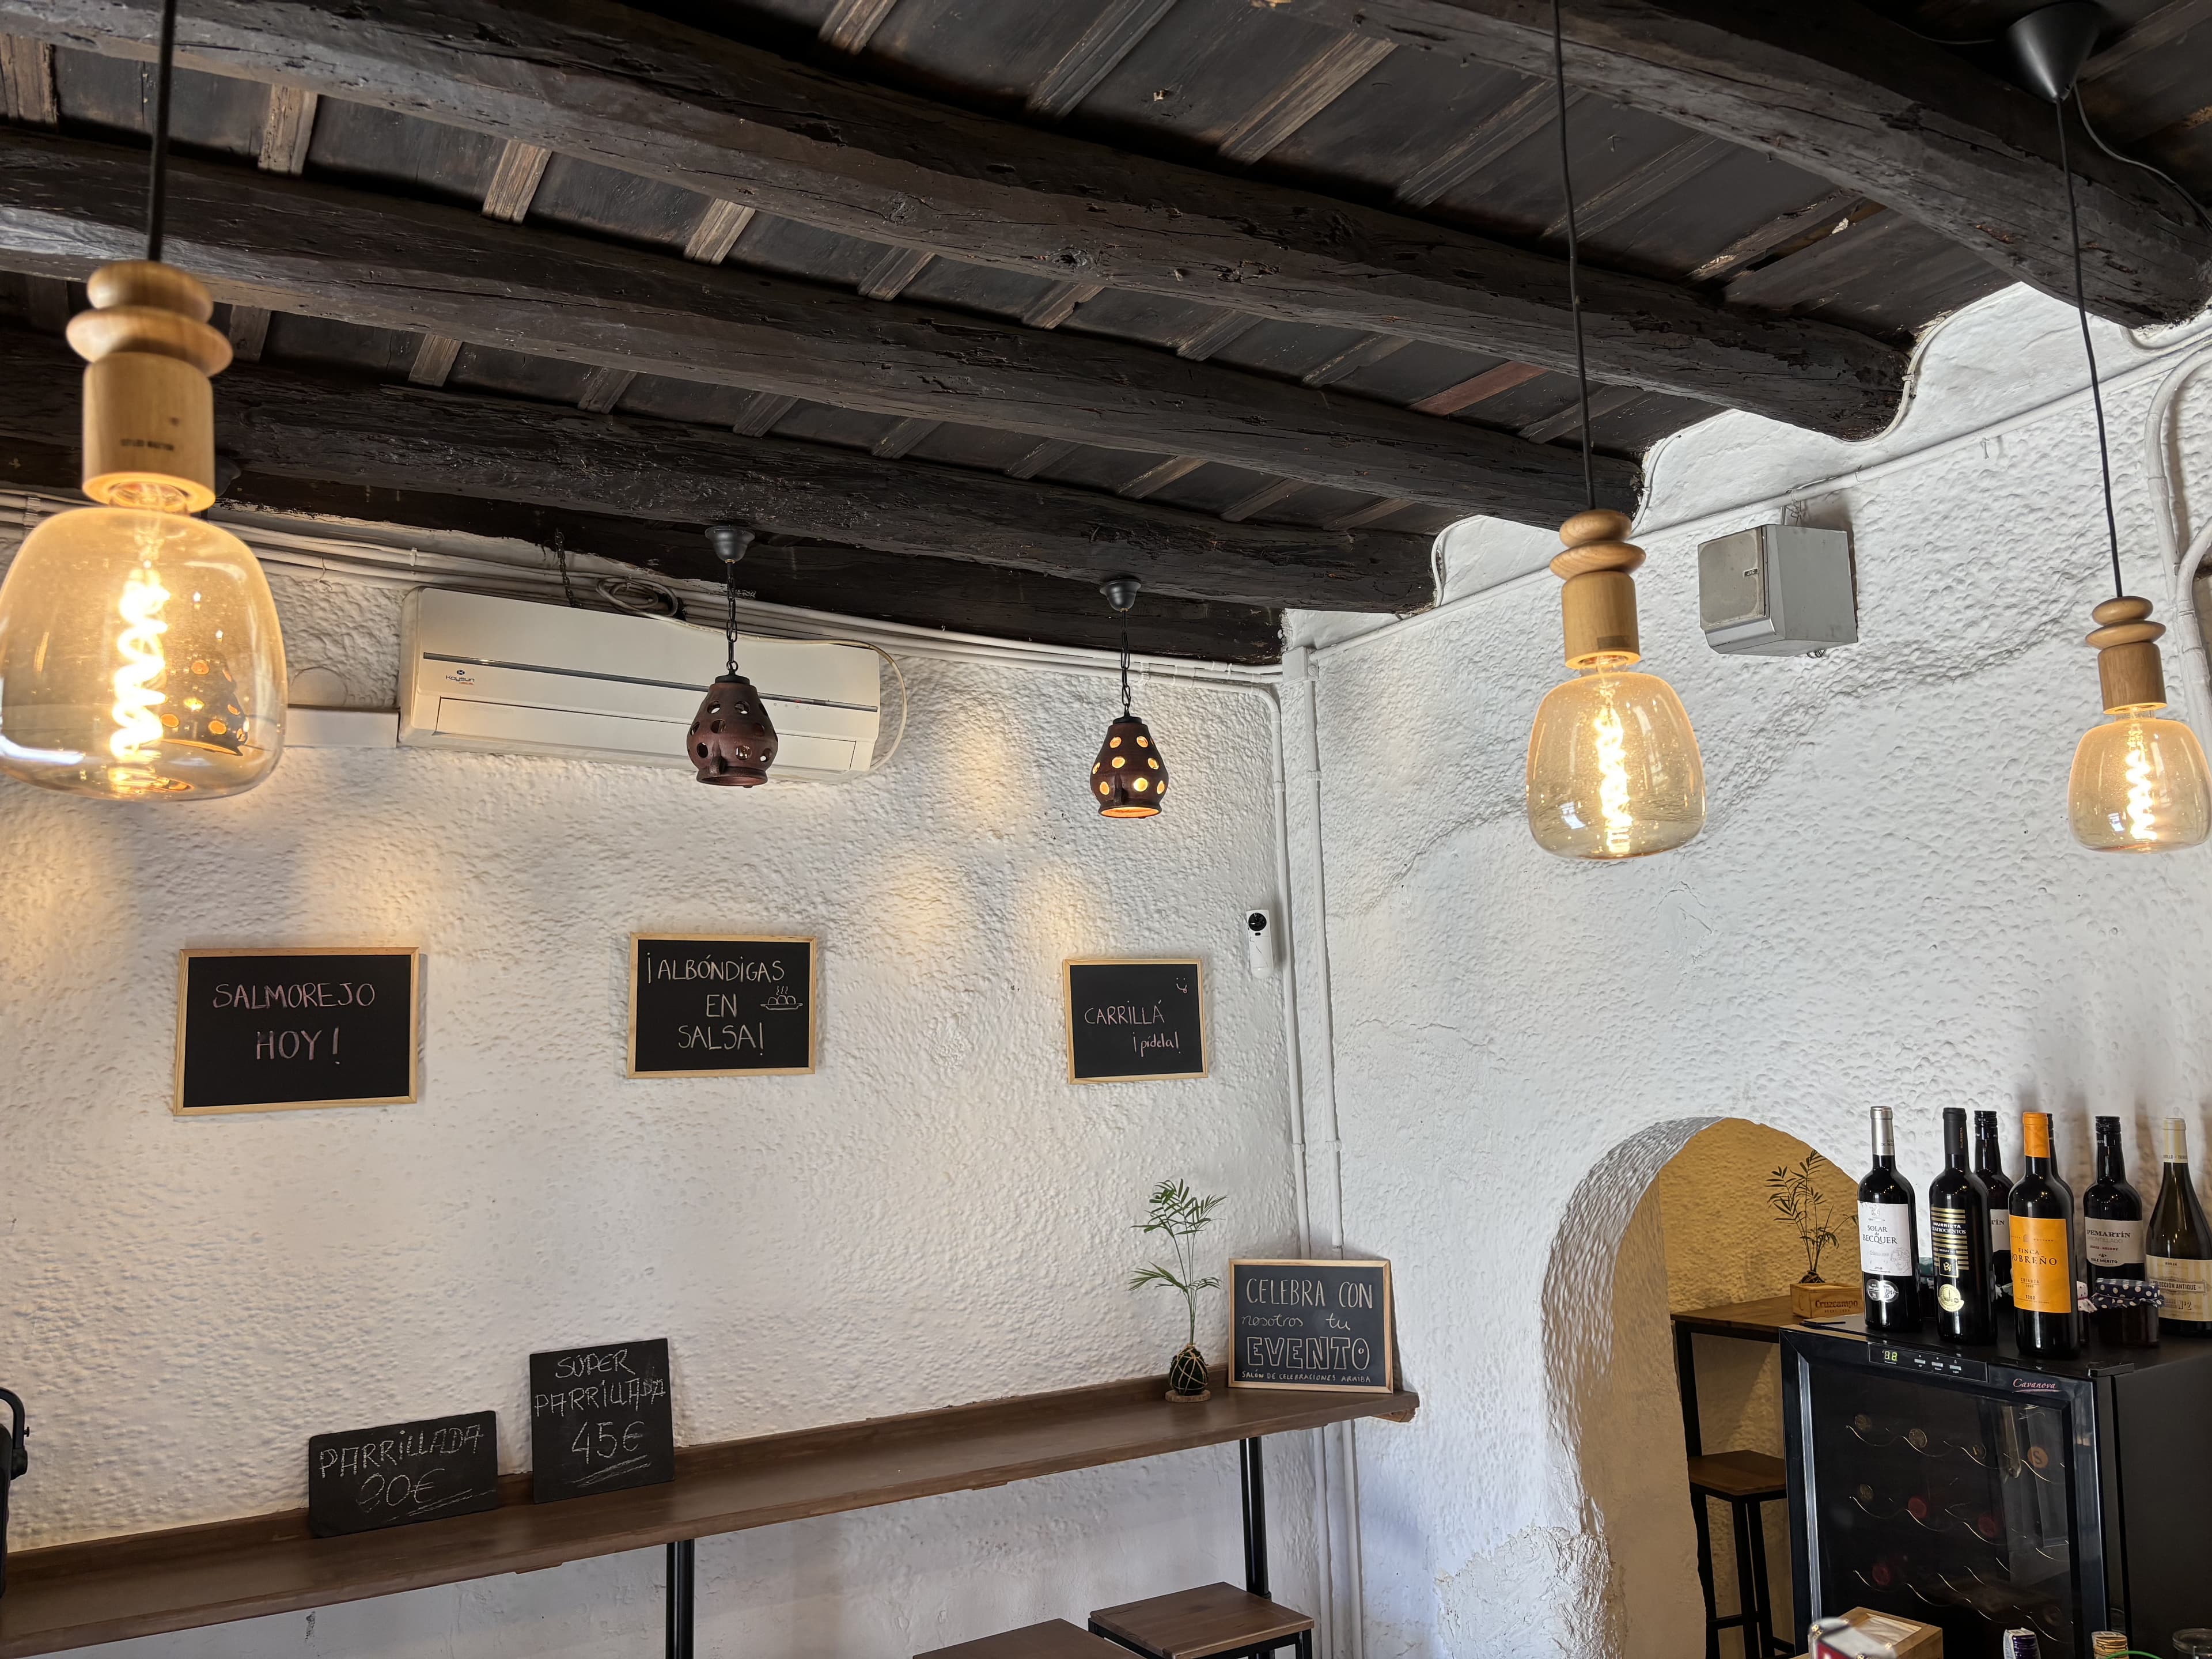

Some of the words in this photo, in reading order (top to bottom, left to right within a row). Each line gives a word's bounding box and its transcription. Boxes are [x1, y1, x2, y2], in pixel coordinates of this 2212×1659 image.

[213, 982, 375, 1009] SALMOREJO
[706, 994, 737, 1018] EN
[678, 1022, 764, 1056] SALSA!
[1862, 1234, 1898, 1244] BECQUER
[1867, 1225, 1888, 1233] SOLAR
[2087, 1229, 2131, 1238] PEMARTÍN
[1246, 1278, 1325, 1306] CELEBRA
[1339, 1281, 1373, 1308] CON
[1815, 1300, 1858, 1308] Cruzcampo
[1241, 1313, 1304, 1327] nosotros
[1325, 1313, 1351, 1331] tu
[555, 1349, 636, 1378] SUPER
[1247, 1336, 1370, 1370] EVENTO
[1242, 1369, 1264, 1378] SALÓN
[1279, 1372, 1336, 1381] CELEBRACIONES
[1341, 1374, 1371, 1382] ARRIBA
[2013, 1378, 2056, 1389] Cavanova
[535, 1377, 666, 1417] PARRILLADA
[319, 1424, 484, 1479] PARRILLADA
[571, 1419, 645, 1464] 45€
